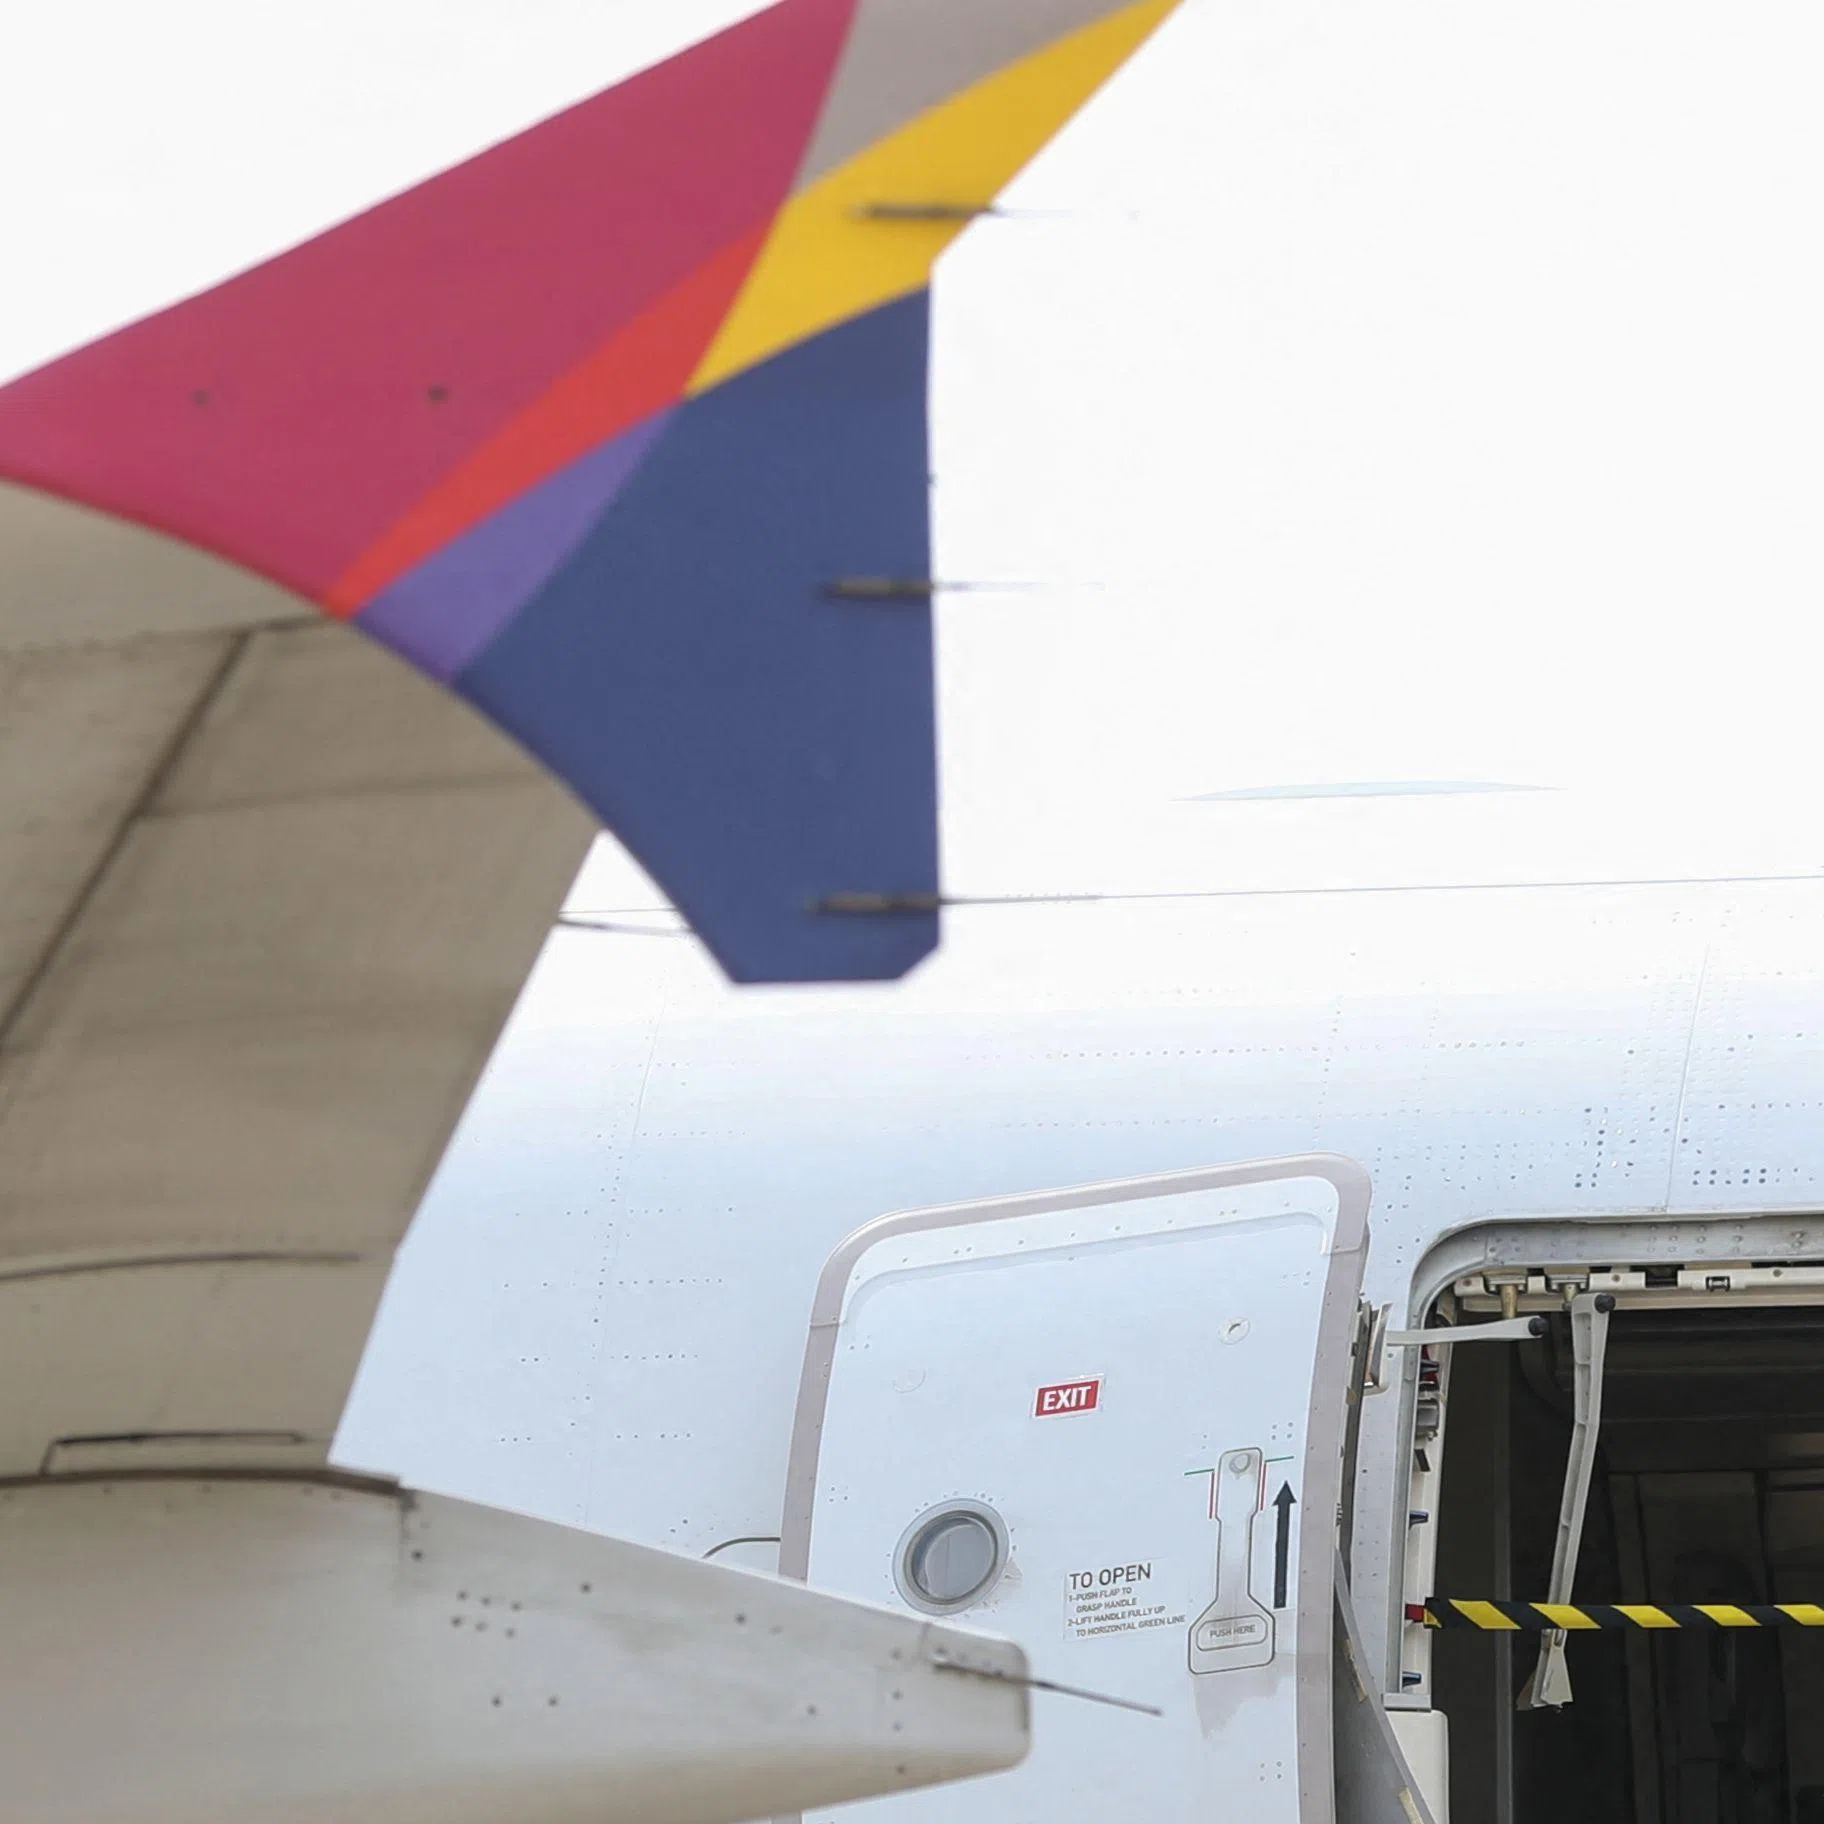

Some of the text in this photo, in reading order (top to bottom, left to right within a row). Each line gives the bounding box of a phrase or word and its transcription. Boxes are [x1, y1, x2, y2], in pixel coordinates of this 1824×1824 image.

[1043, 1386, 1091, 1411] EXIT
[1069, 1562, 1151, 1590] TO OPEN
[1098, 1588, 1120, 1598] FLAP
[1122, 1586, 1132, 1594] TO
[1076, 1598, 1137, 1613] GRASP HANDLE
[1093, 1611, 1126, 1622] HANDLE
[1128, 1607, 1153, 1618] FULLY
[1153, 1605, 1166, 1614] UP
[1076, 1614, 1186, 1637] TO HORIZONTAL GREEN LINE
[1210, 1624, 1256, 1638] PUSH HERE
